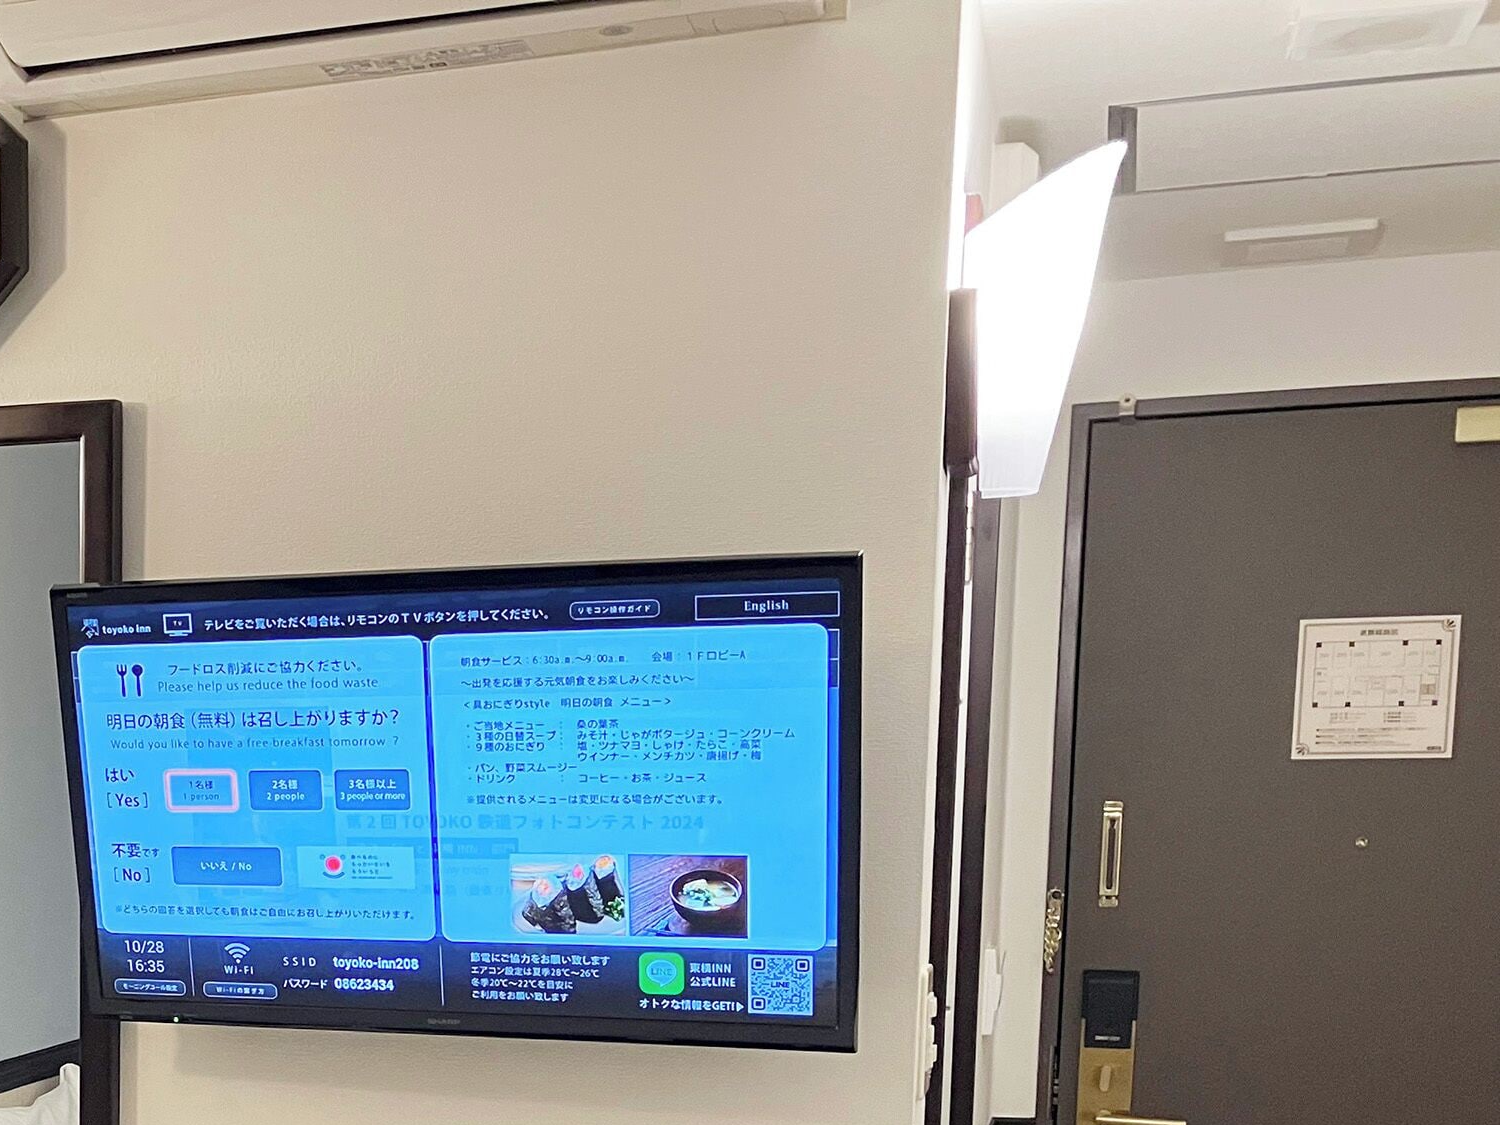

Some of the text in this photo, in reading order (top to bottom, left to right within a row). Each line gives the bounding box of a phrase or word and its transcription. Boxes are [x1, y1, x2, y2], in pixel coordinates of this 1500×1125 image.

[743, 599, 789, 613] English
[102, 624, 152, 637] toyoko inn
[167, 659, 363, 677] フードロス削減にご協力ください。
[158, 677, 378, 693] Please help us reduce the food waste
[560, 696, 613, 708] 明日の朝食
[110, 734, 145, 749] Would
[148, 739, 168, 751] you
[171, 736, 190, 748] like
[194, 738, 205, 748] to
[208, 735, 233, 748] have
[237, 738, 244, 747] a
[247, 735, 269, 747] free
[272, 734, 325, 748] breakfast
[329, 735, 386, 747] tomorrow
[104, 767, 135, 783] はい
[266, 792, 305, 802] 2 people
[340, 791, 406, 802] 3 people or more
[111, 842, 160, 859] 不要です
[200, 861, 228, 872] いいえ
[238, 861, 253, 871] No
[124, 939, 165, 954] 10/28
[126, 958, 165, 974] 16:35
[333, 955, 419, 971] toyoko-inn208
[650, 967, 673, 976] LINE
[282, 976, 395, 992] パスワード 08623434
[689, 976, 736, 987] 公式LINE
